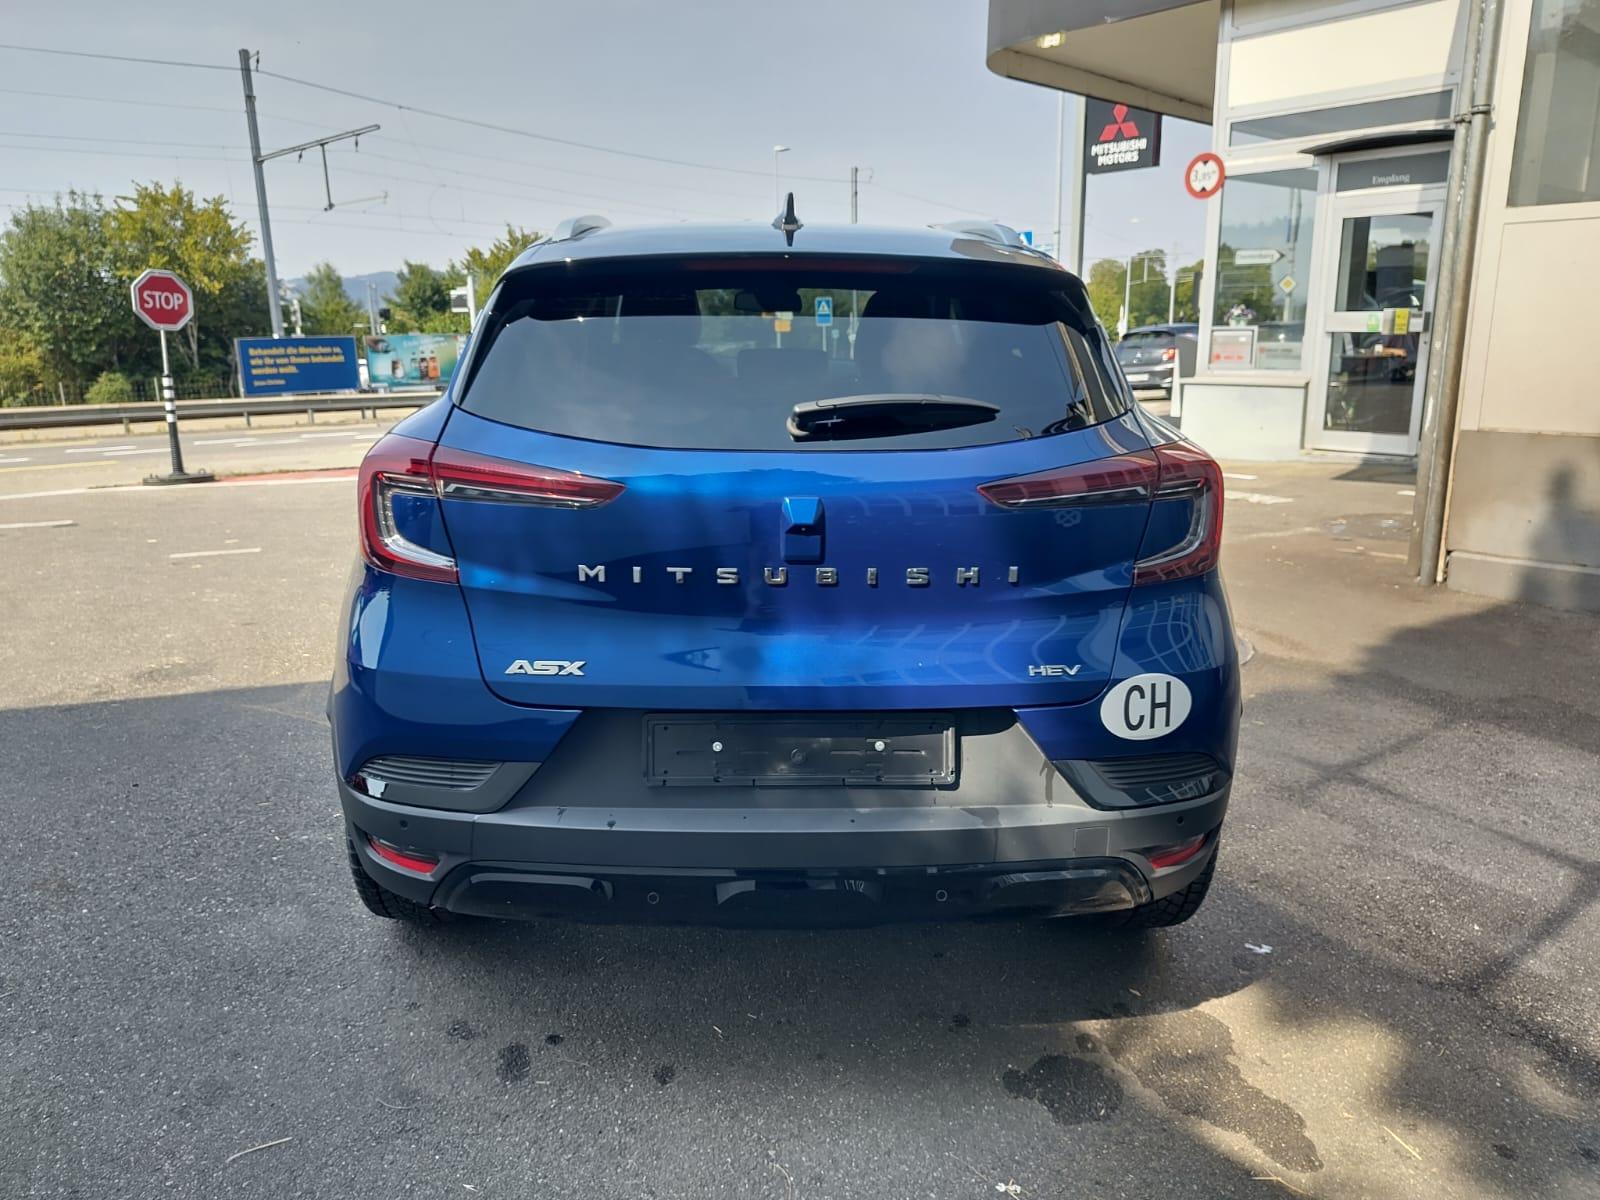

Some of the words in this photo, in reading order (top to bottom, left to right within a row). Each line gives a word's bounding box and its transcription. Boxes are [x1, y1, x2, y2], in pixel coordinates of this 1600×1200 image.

[1091, 138, 1147, 156] MITSUBISHI
[1098, 150, 1139, 166] MOTORS
[143, 290, 183, 310] STOP
[578, 564, 1018, 585] MITSUBISHI
[504, 660, 586, 675] ASX
[1028, 664, 1081, 677] HEV
[1123, 681, 1171, 731] CH
